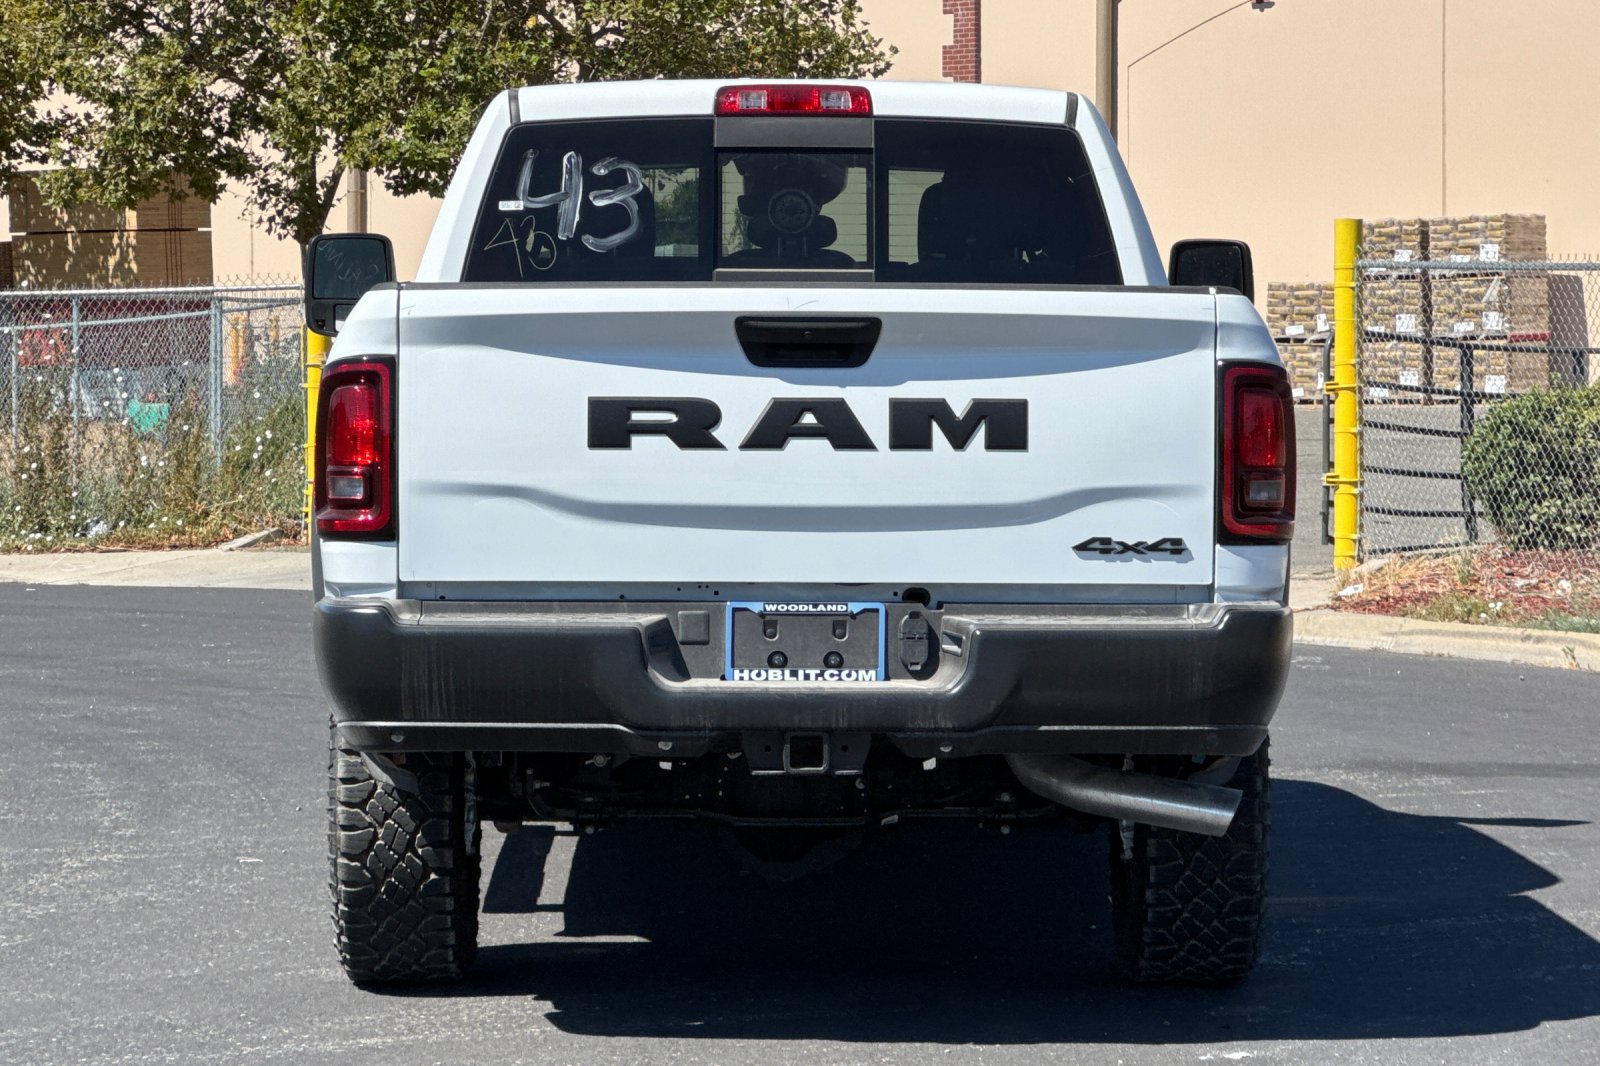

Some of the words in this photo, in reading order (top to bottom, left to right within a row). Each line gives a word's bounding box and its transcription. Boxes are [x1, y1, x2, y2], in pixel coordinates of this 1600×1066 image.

[516, 149, 643, 252] 43
[588, 397, 1028, 450] RAM
[764, 603, 848, 612] WOODLAND
[733, 669, 877, 682] HOBLIT.COM
